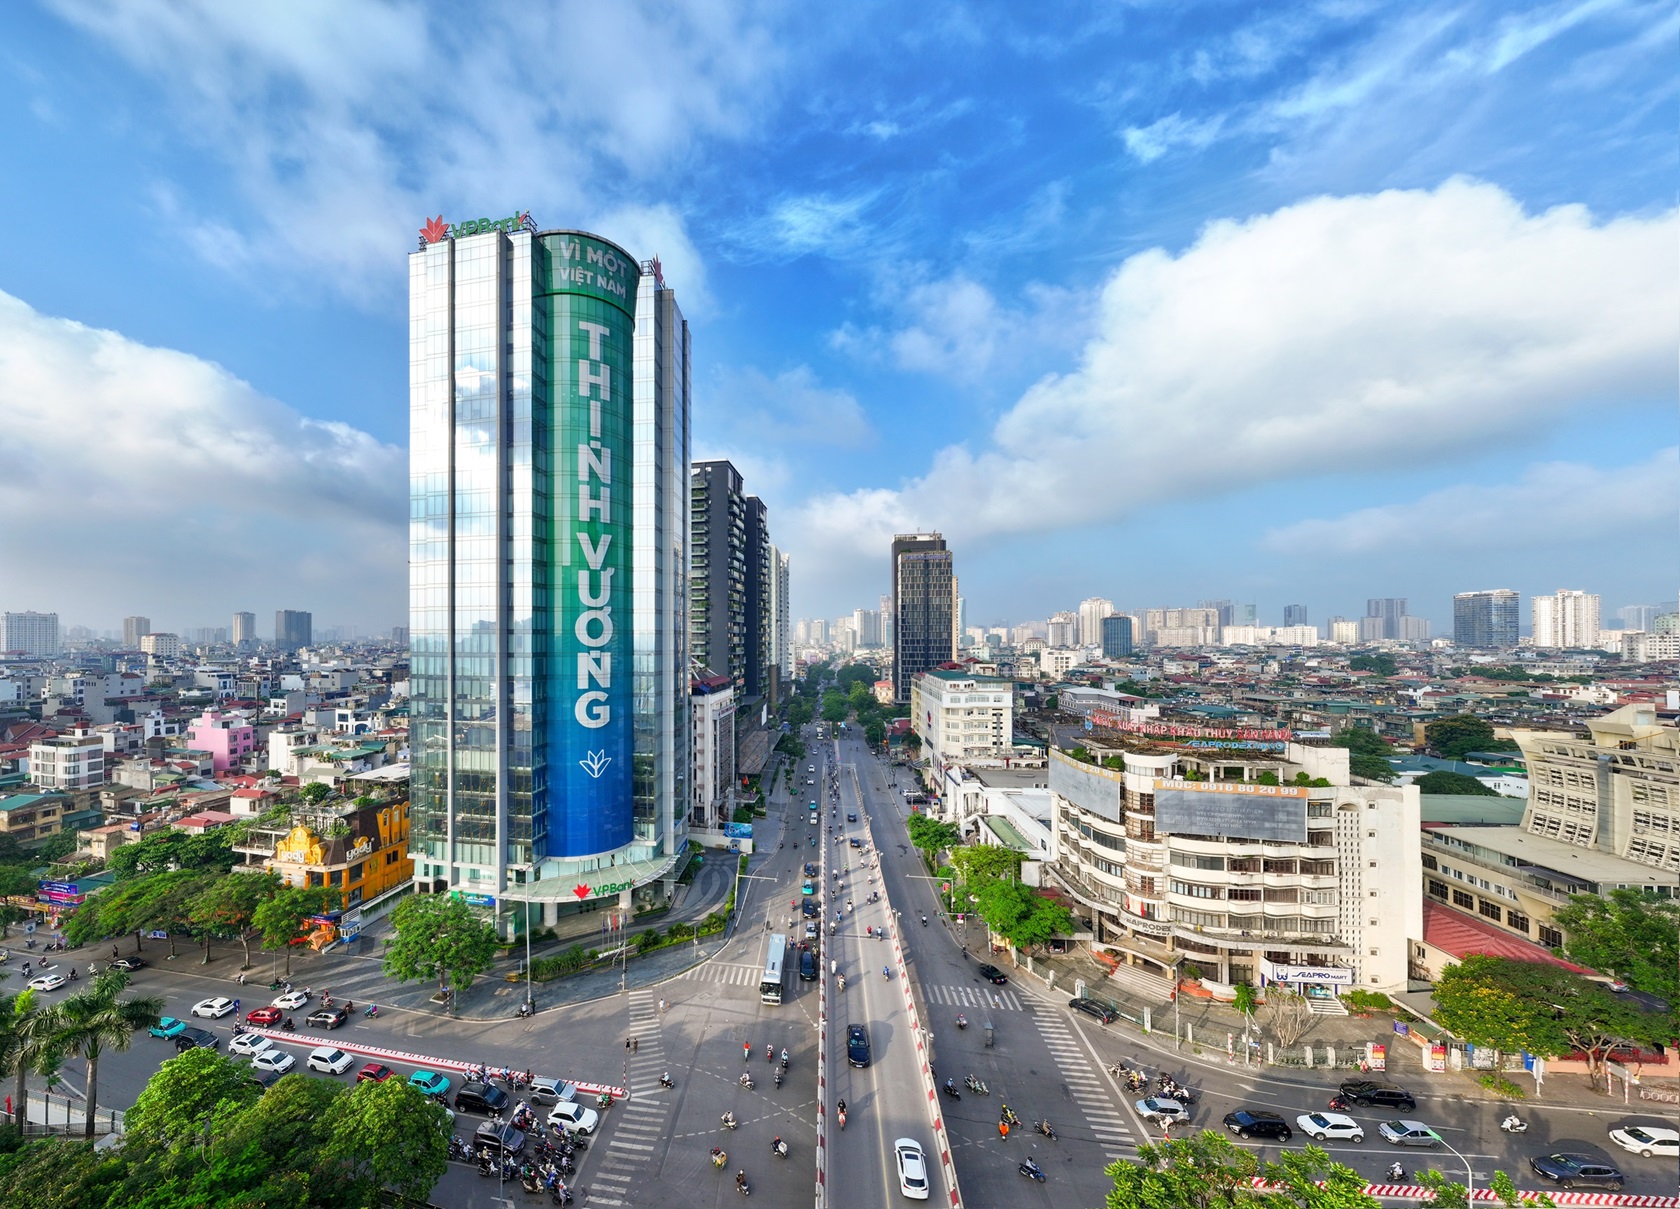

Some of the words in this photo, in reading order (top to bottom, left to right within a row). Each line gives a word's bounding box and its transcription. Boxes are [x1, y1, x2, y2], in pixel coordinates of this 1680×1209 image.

[451, 211, 526, 239] VPBank
[559, 238, 581, 261] VÌ
[587, 246, 627, 278] MỘT
[559, 266, 594, 286] VIỆT
[597, 275, 627, 299] NAM
[577, 321, 611, 524] THỊNH
[574, 532, 615, 729] VƯỢNG
[1200, 783, 1233, 791] 0916
[1237, 784, 1255, 793] 80
[1259, 786, 1276, 794] 20
[1280, 787, 1298, 795] 99
[280, 850, 305, 863] yody
[346, 842, 372, 861] yody
[593, 878, 635, 897] VPBank
[1292, 971, 1331, 979] SEAPRO
